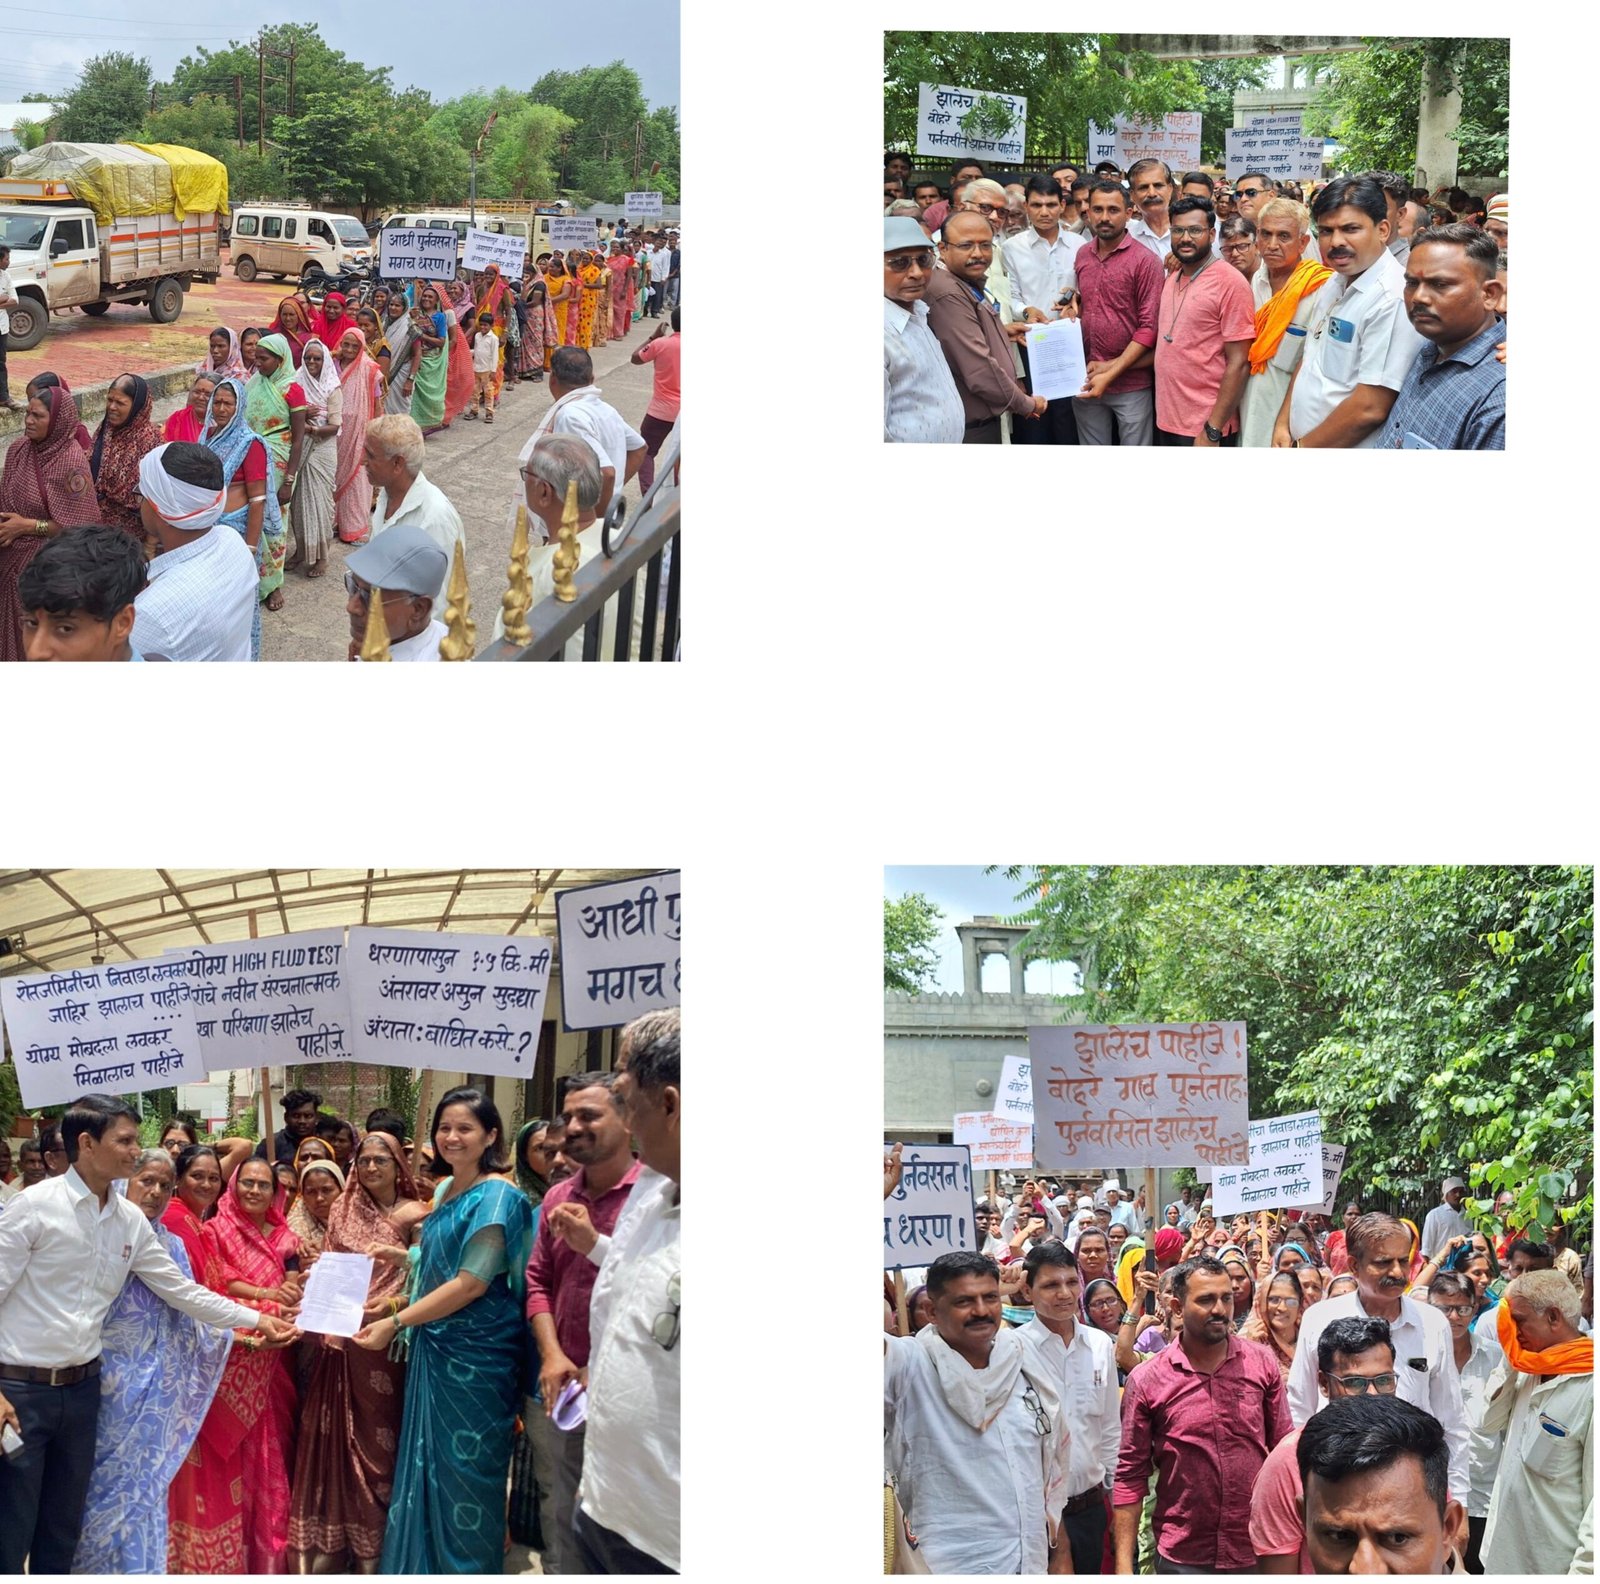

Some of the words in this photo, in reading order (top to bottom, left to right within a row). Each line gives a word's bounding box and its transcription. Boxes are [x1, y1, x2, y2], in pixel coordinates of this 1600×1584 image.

[936, 89, 974, 109] झालेच
[387, 231, 415, 248] आधी
[388, 256, 416, 270] मगच
[578, 885, 658, 941] आधी
[186, 950, 228, 978] योग्य
[232, 952, 266, 973] HIGH
[271, 949, 305, 969] FLUD
[307, 944, 342, 966] TEST
[368, 943, 460, 973] धरणापासुन
[16, 971, 100, 1002] शेतजमिनीचा
[105, 967, 151, 987] निवाडा
[220, 976, 259, 1003] नवीन
[261, 971, 341, 998] संरचनात्मक
[378, 974, 441, 1001] अंतरावर
[441, 983, 486, 1011] असुन
[587, 962, 666, 1005] मगच
[48, 999, 91, 1025] जाहिर
[98, 993, 144, 1019] झालाच
[150, 982, 191, 1009] पाहीजे
[221, 1007, 270, 1037] परिक्षण
[270, 1004, 314, 1036] झालेच
[25, 1043, 62, 1064] योग्य
[67, 1037, 119, 1058] मोबदला
[125, 1028, 172, 1048] लवकर
[425, 1018, 479, 1048] बाधित
[1074, 1025, 1152, 1068] झालेच
[1157, 1023, 1227, 1062] पाहीजे
[73, 1063, 135, 1087] मिळालाच
[141, 1048, 184, 1077] पाहीजे
[1154, 1107, 1218, 1150] झालेच
[1261, 1139, 1290, 1156] झालाच
[1294, 1130, 1321, 1149] पाहीजे
[1194, 1132, 1249, 1166] पाहीजे
[1273, 1163, 1305, 1177] लवकर
[1241, 1186, 1278, 1203] मिळालाच
[1281, 1177, 1311, 1198] पाहीजे
